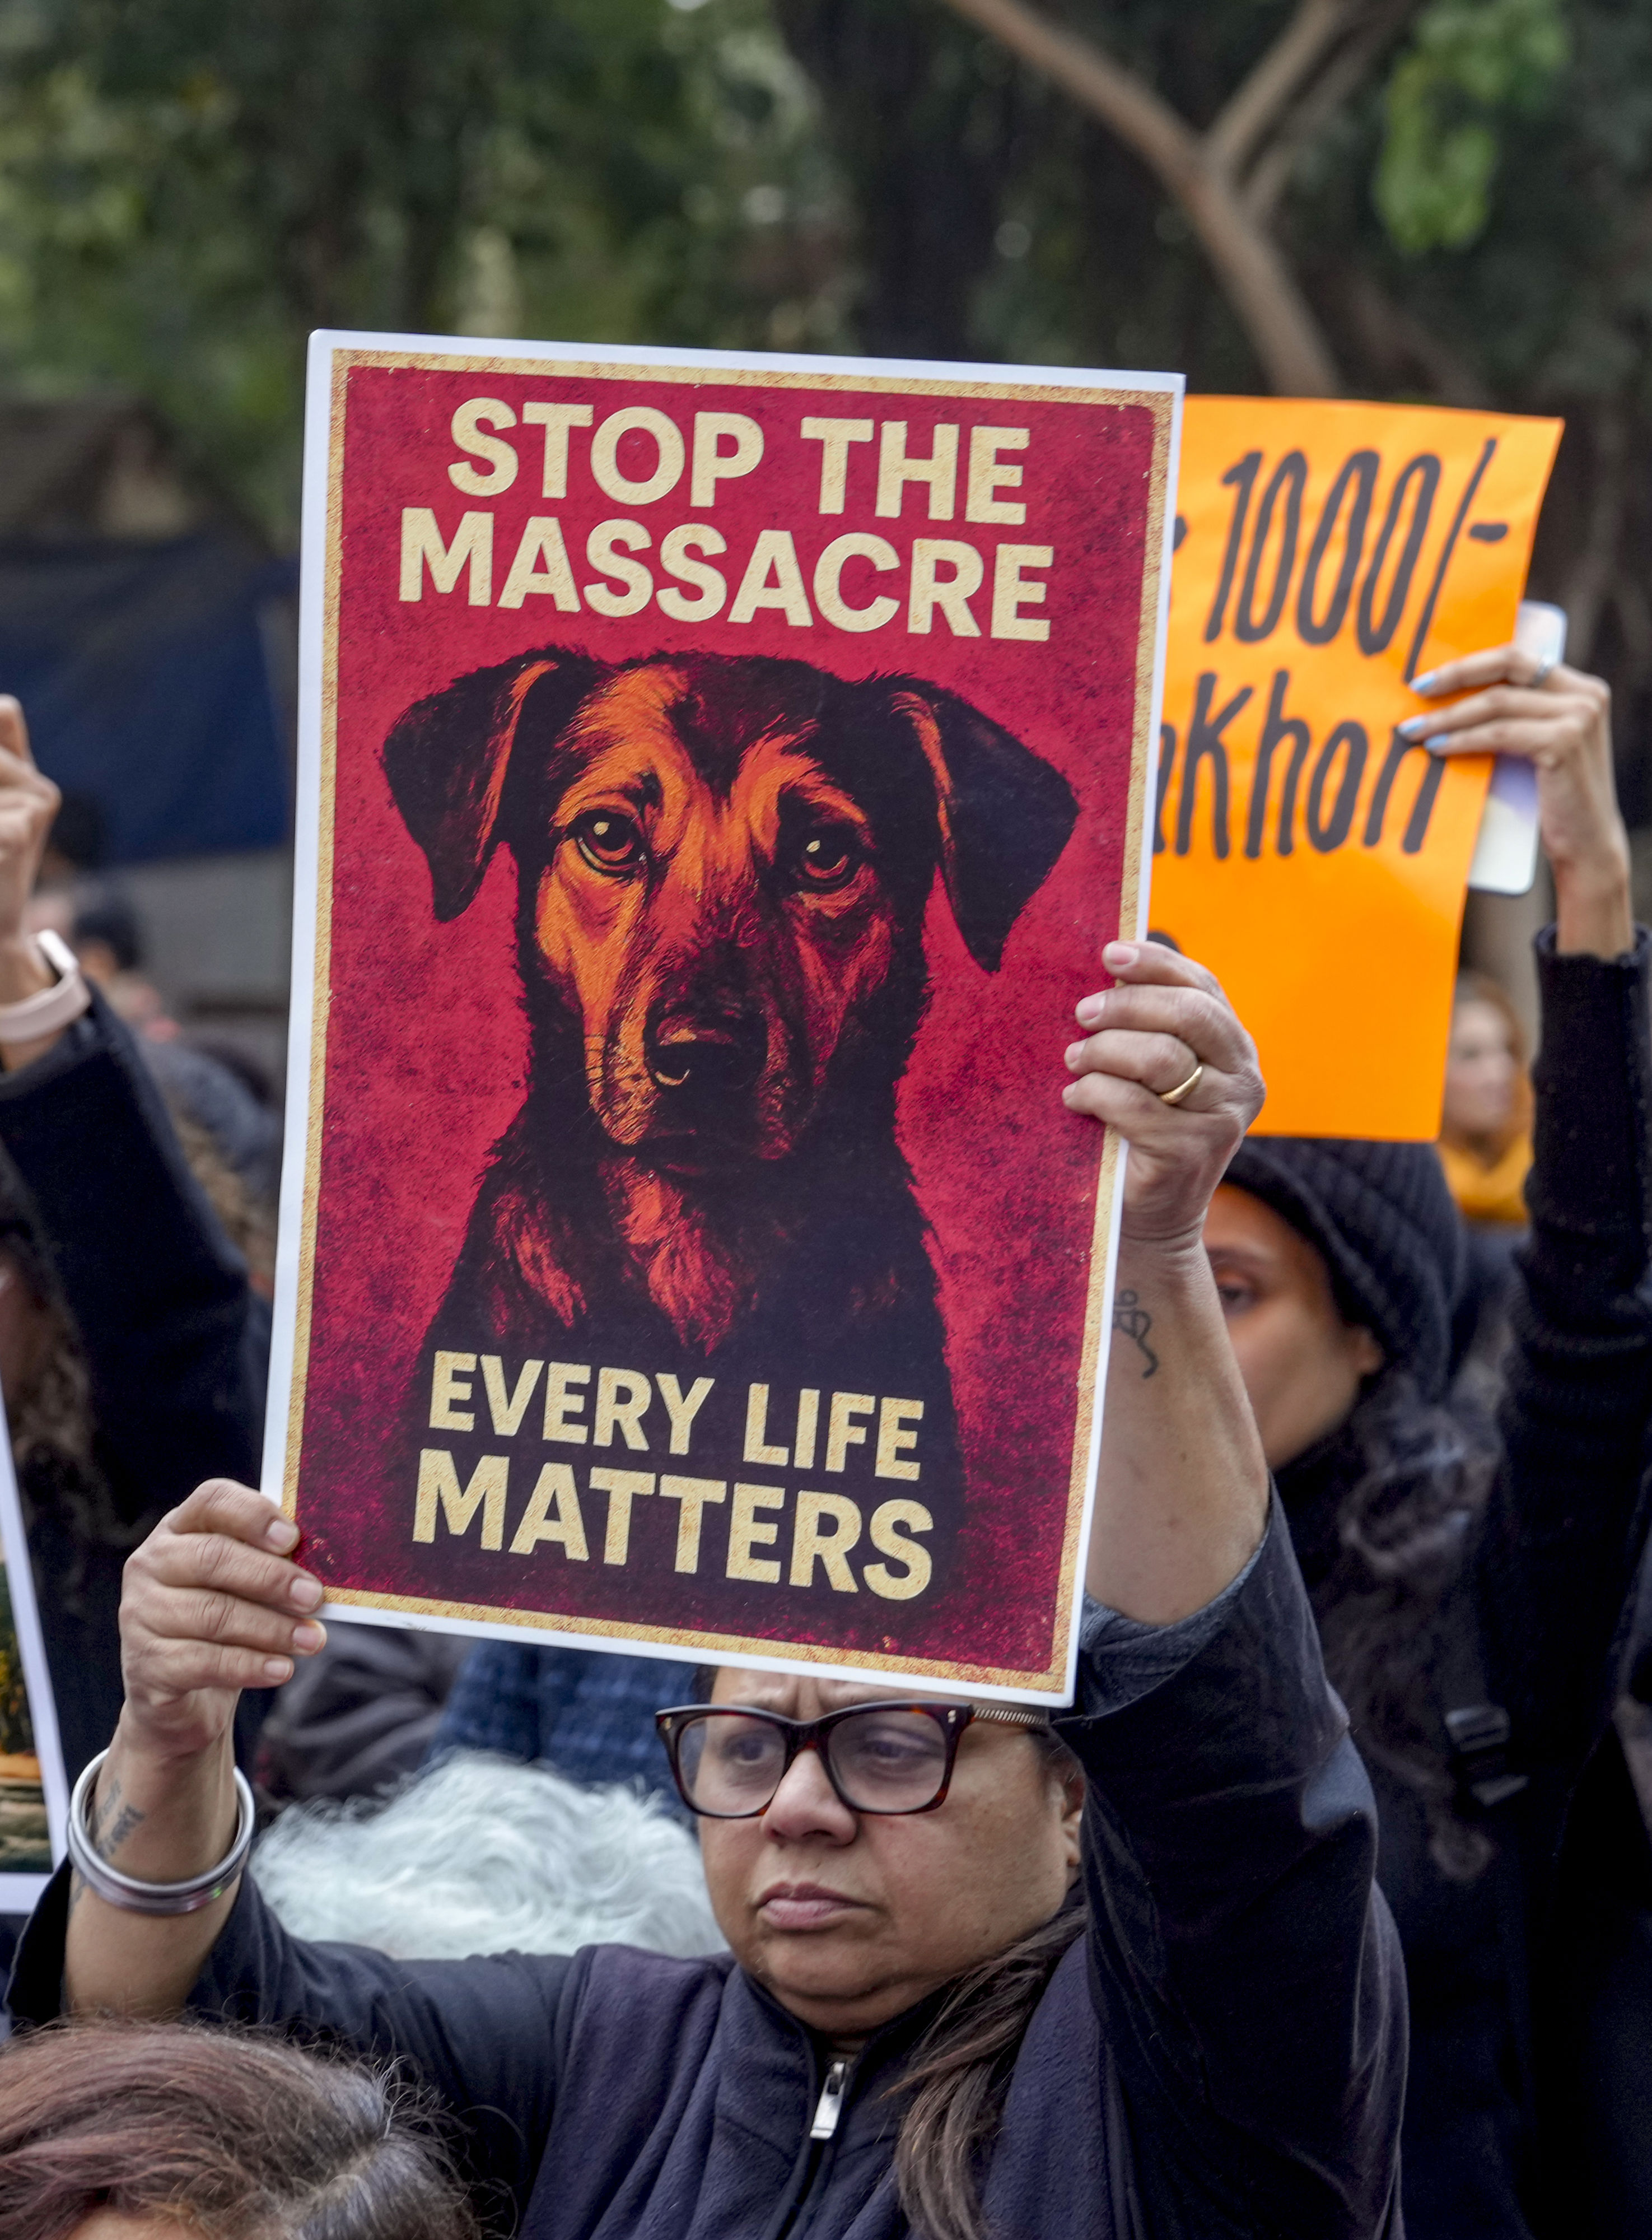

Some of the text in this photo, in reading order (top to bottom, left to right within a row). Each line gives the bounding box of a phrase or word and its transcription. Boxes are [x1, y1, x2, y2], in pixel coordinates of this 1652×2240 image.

[447, 397, 1030, 526] STOP THE
[398, 506, 1054, 642] MASSACRE
[1204, 438, 1509, 686] 1000/-
[428, 1349, 925, 1482] EVERY LIFE
[411, 1447, 934, 1601] MATTERS
